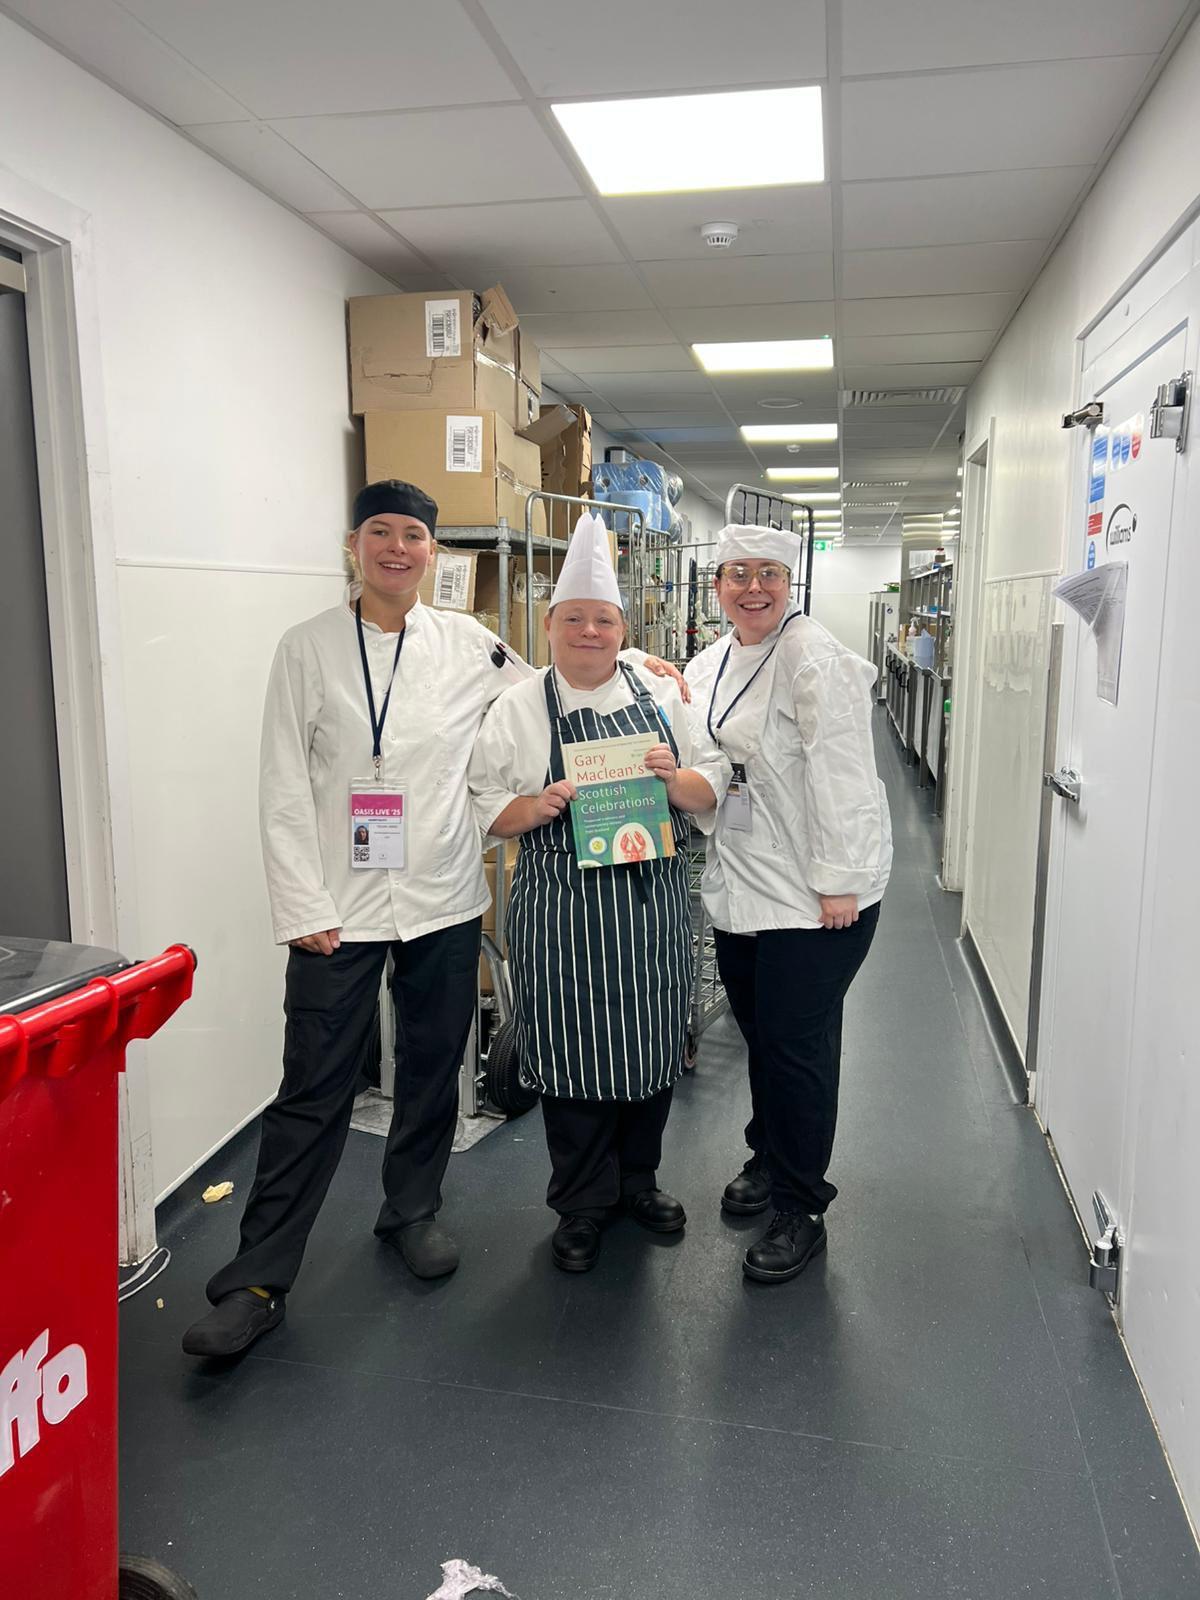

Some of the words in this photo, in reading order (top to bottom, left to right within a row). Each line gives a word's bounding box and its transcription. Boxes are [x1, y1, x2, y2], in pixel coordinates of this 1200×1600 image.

[575, 753, 606, 767] Gary
[577, 764, 645, 782] Maclean's
[579, 784, 627, 800] Scottish
[581, 796, 656, 814] Celebrations
